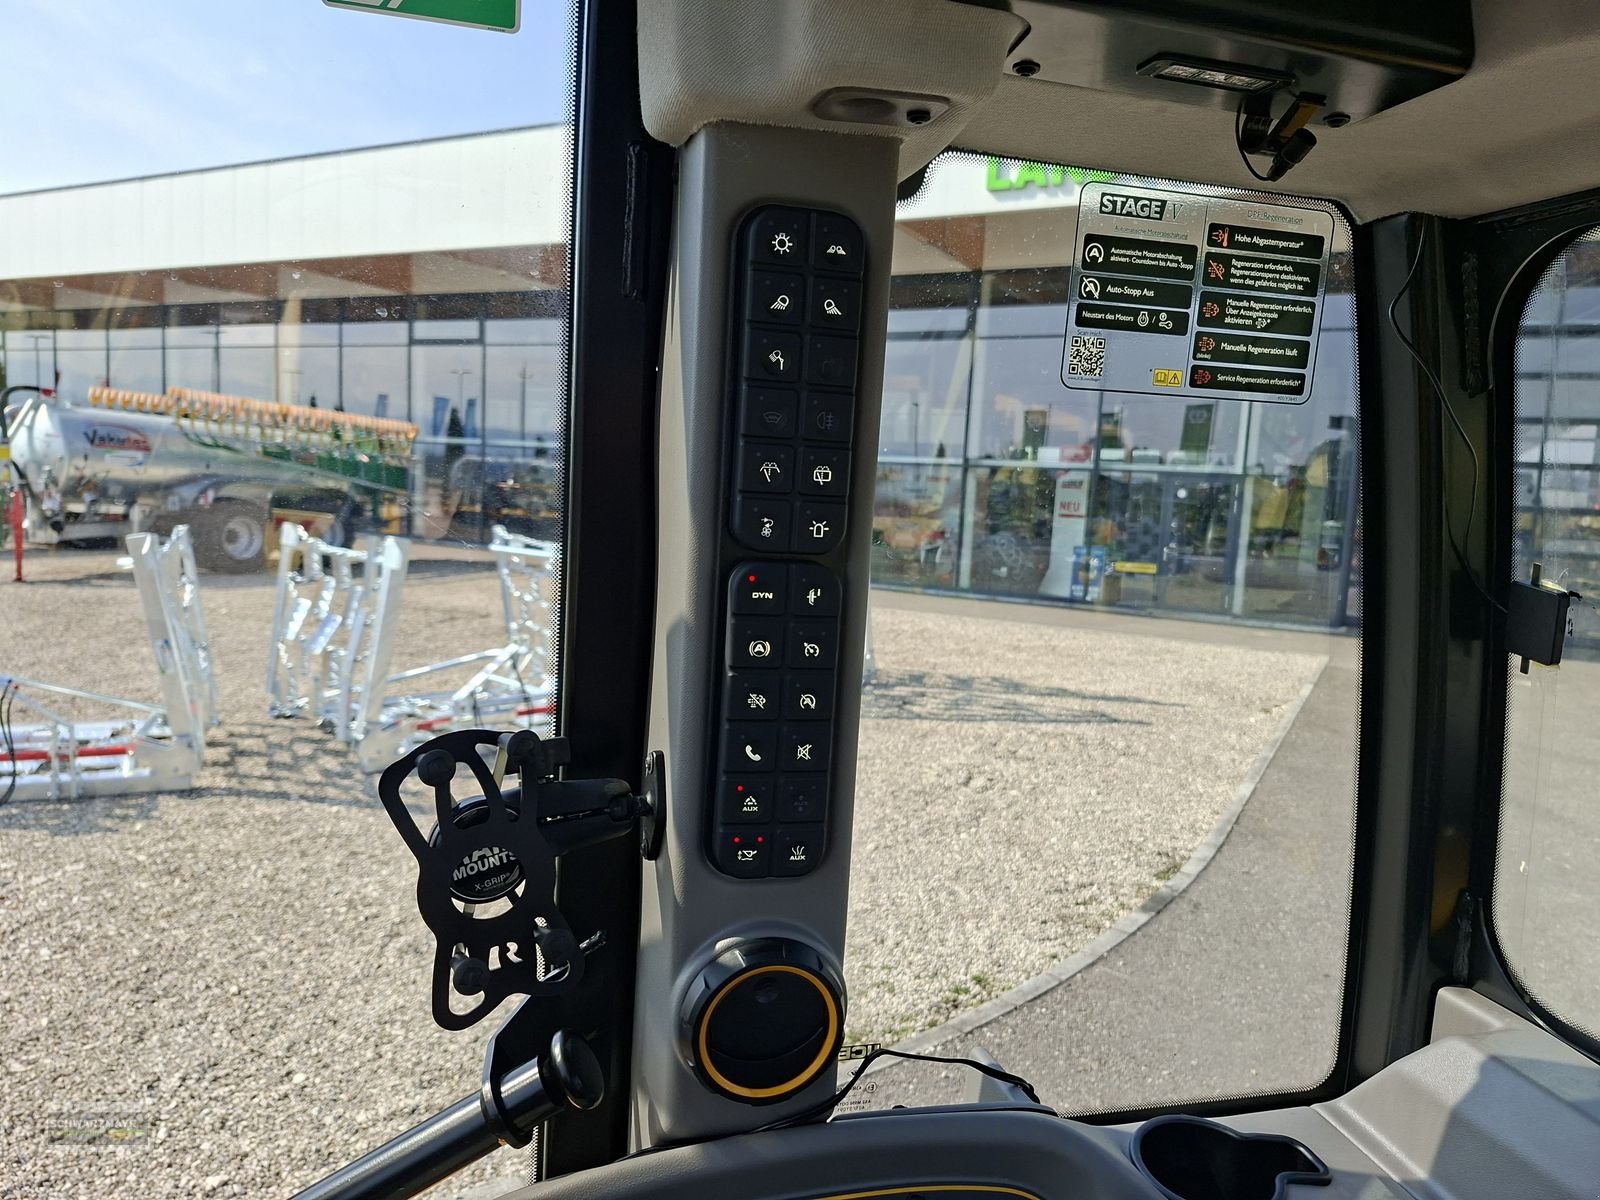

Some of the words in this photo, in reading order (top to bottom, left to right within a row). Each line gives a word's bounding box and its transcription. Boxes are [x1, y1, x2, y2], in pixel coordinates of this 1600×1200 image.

[1101, 195, 1162, 218] STAGE
[1234, 233, 1252, 242] Hohe
[1110, 247, 1142, 257] Automatische
[1142, 251, 1183, 262] Motorabschaltung
[1131, 257, 1159, 266] Countdown
[1231, 258, 1264, 269] Regeneration
[1230, 267, 1280, 280] Regenerationssperre
[1244, 278, 1255, 286] dies
[1255, 278, 1277, 288] gefahrlos
[1277, 280, 1296, 290] möglich
[1106, 284, 1142, 296] Auto-Stopp
[1142, 288, 1155, 297] Aus
[1226, 298, 1249, 308] Manuelle
[1250, 300, 1282, 311] Regeneration
[1082, 310, 1105, 319] Neustart
[1105, 312, 1115, 320] des
[1115, 313, 1134, 322] Motors
[1225, 305, 1239, 315] Über
[1239, 308, 1278, 319] Anzeigekonsole
[1224, 316, 1253, 326] aktivieren
[1220, 342, 1247, 352] Manuelle
[1247, 344, 1284, 355] Regeneration
[1285, 347, 1298, 357] läuft
[1217, 373, 1236, 382] Service
[1236, 375, 1269, 385] Regeneration
[1059, 500, 1080, 512] NEU
